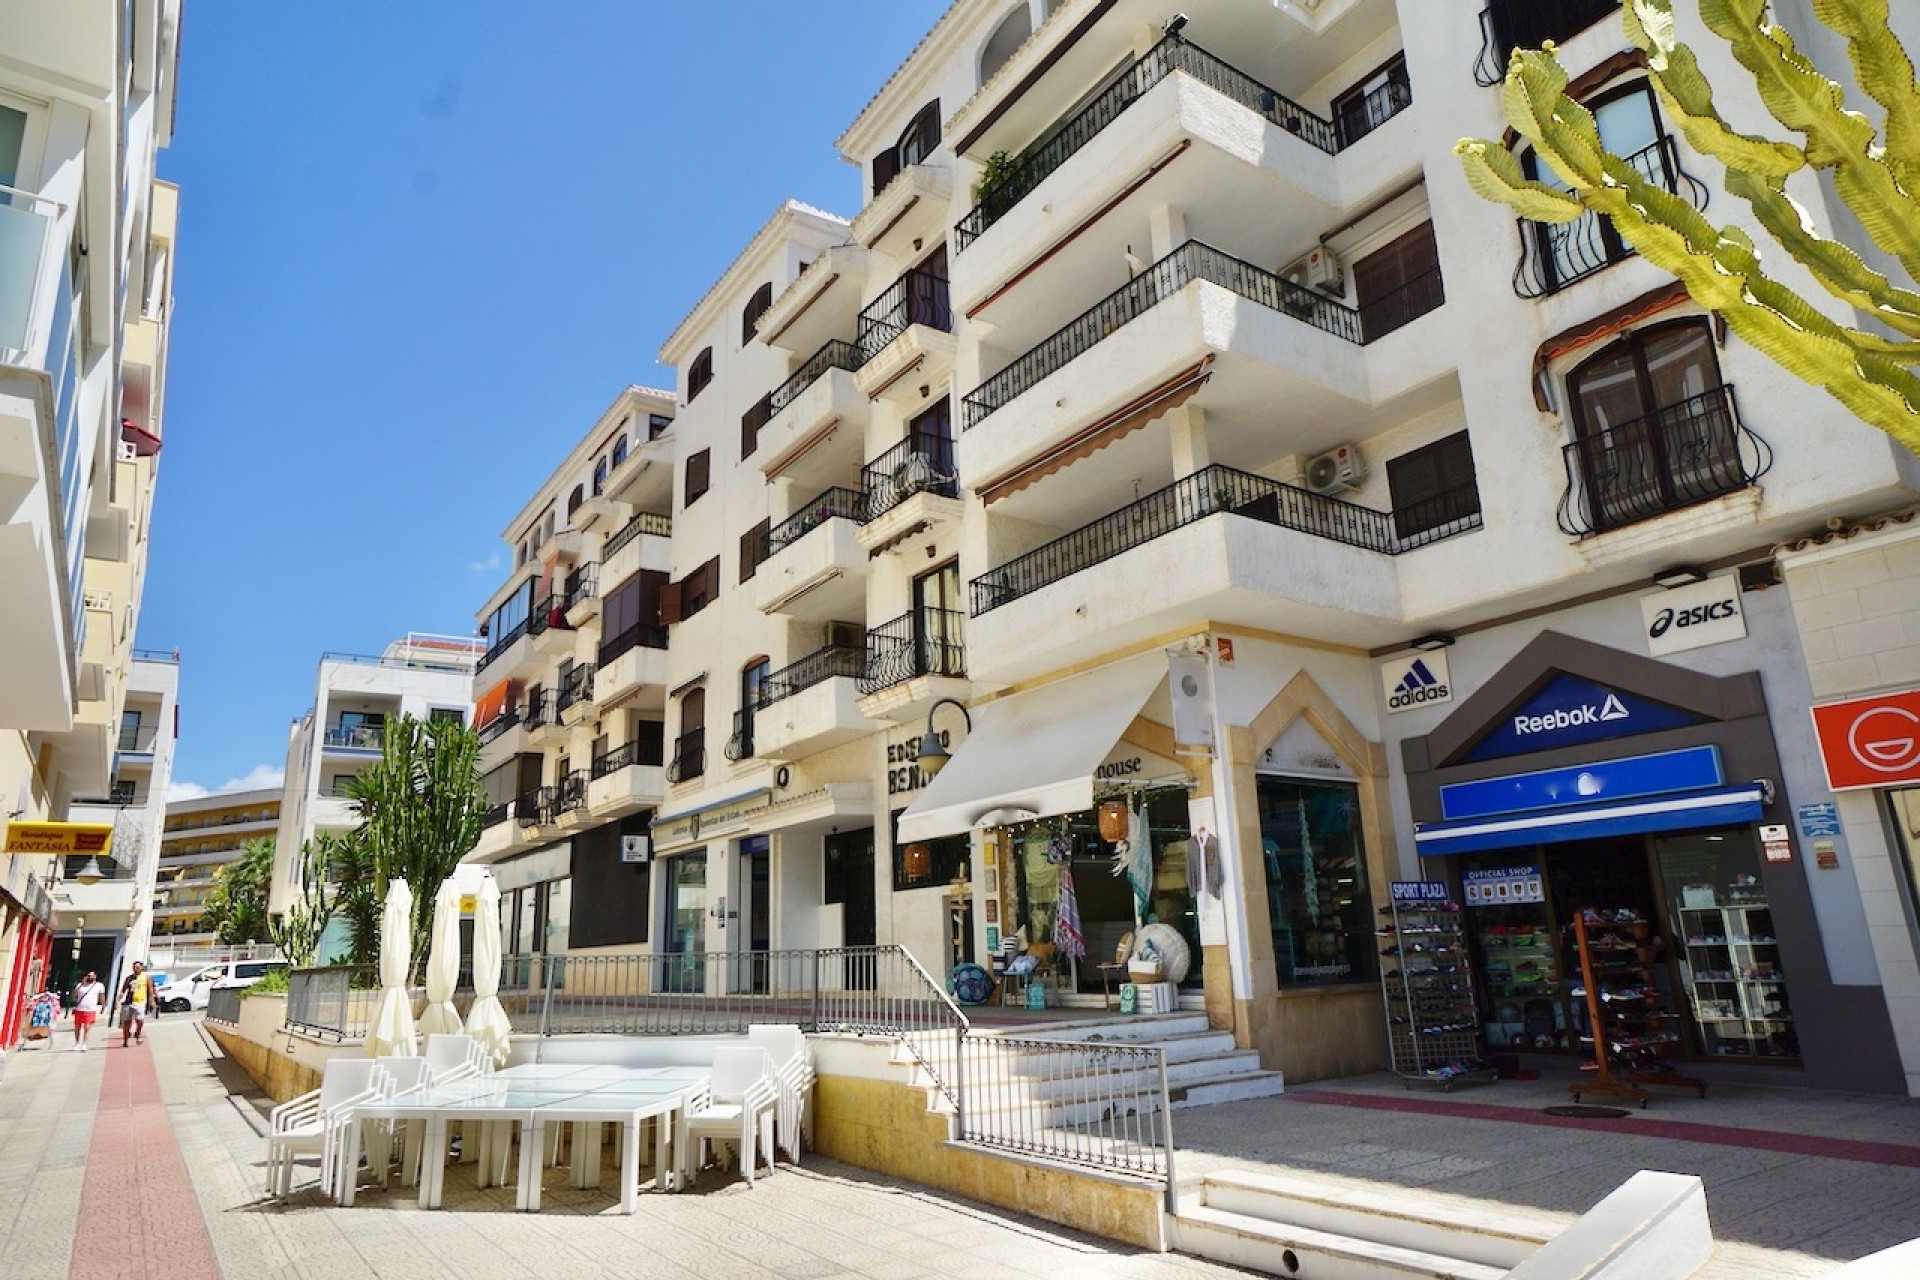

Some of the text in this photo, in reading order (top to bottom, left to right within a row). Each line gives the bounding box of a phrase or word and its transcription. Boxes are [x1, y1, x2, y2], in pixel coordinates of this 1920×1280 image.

[1676, 599, 1735, 628] asics
[1389, 685, 1448, 709] adidas
[1514, 704, 1599, 736] Reebok
[8, 841, 71, 852] FANTASIA
[1468, 866, 1534, 880] OFFICIAL SHOP
[1392, 883, 1447, 899] SPORT PLAZA
